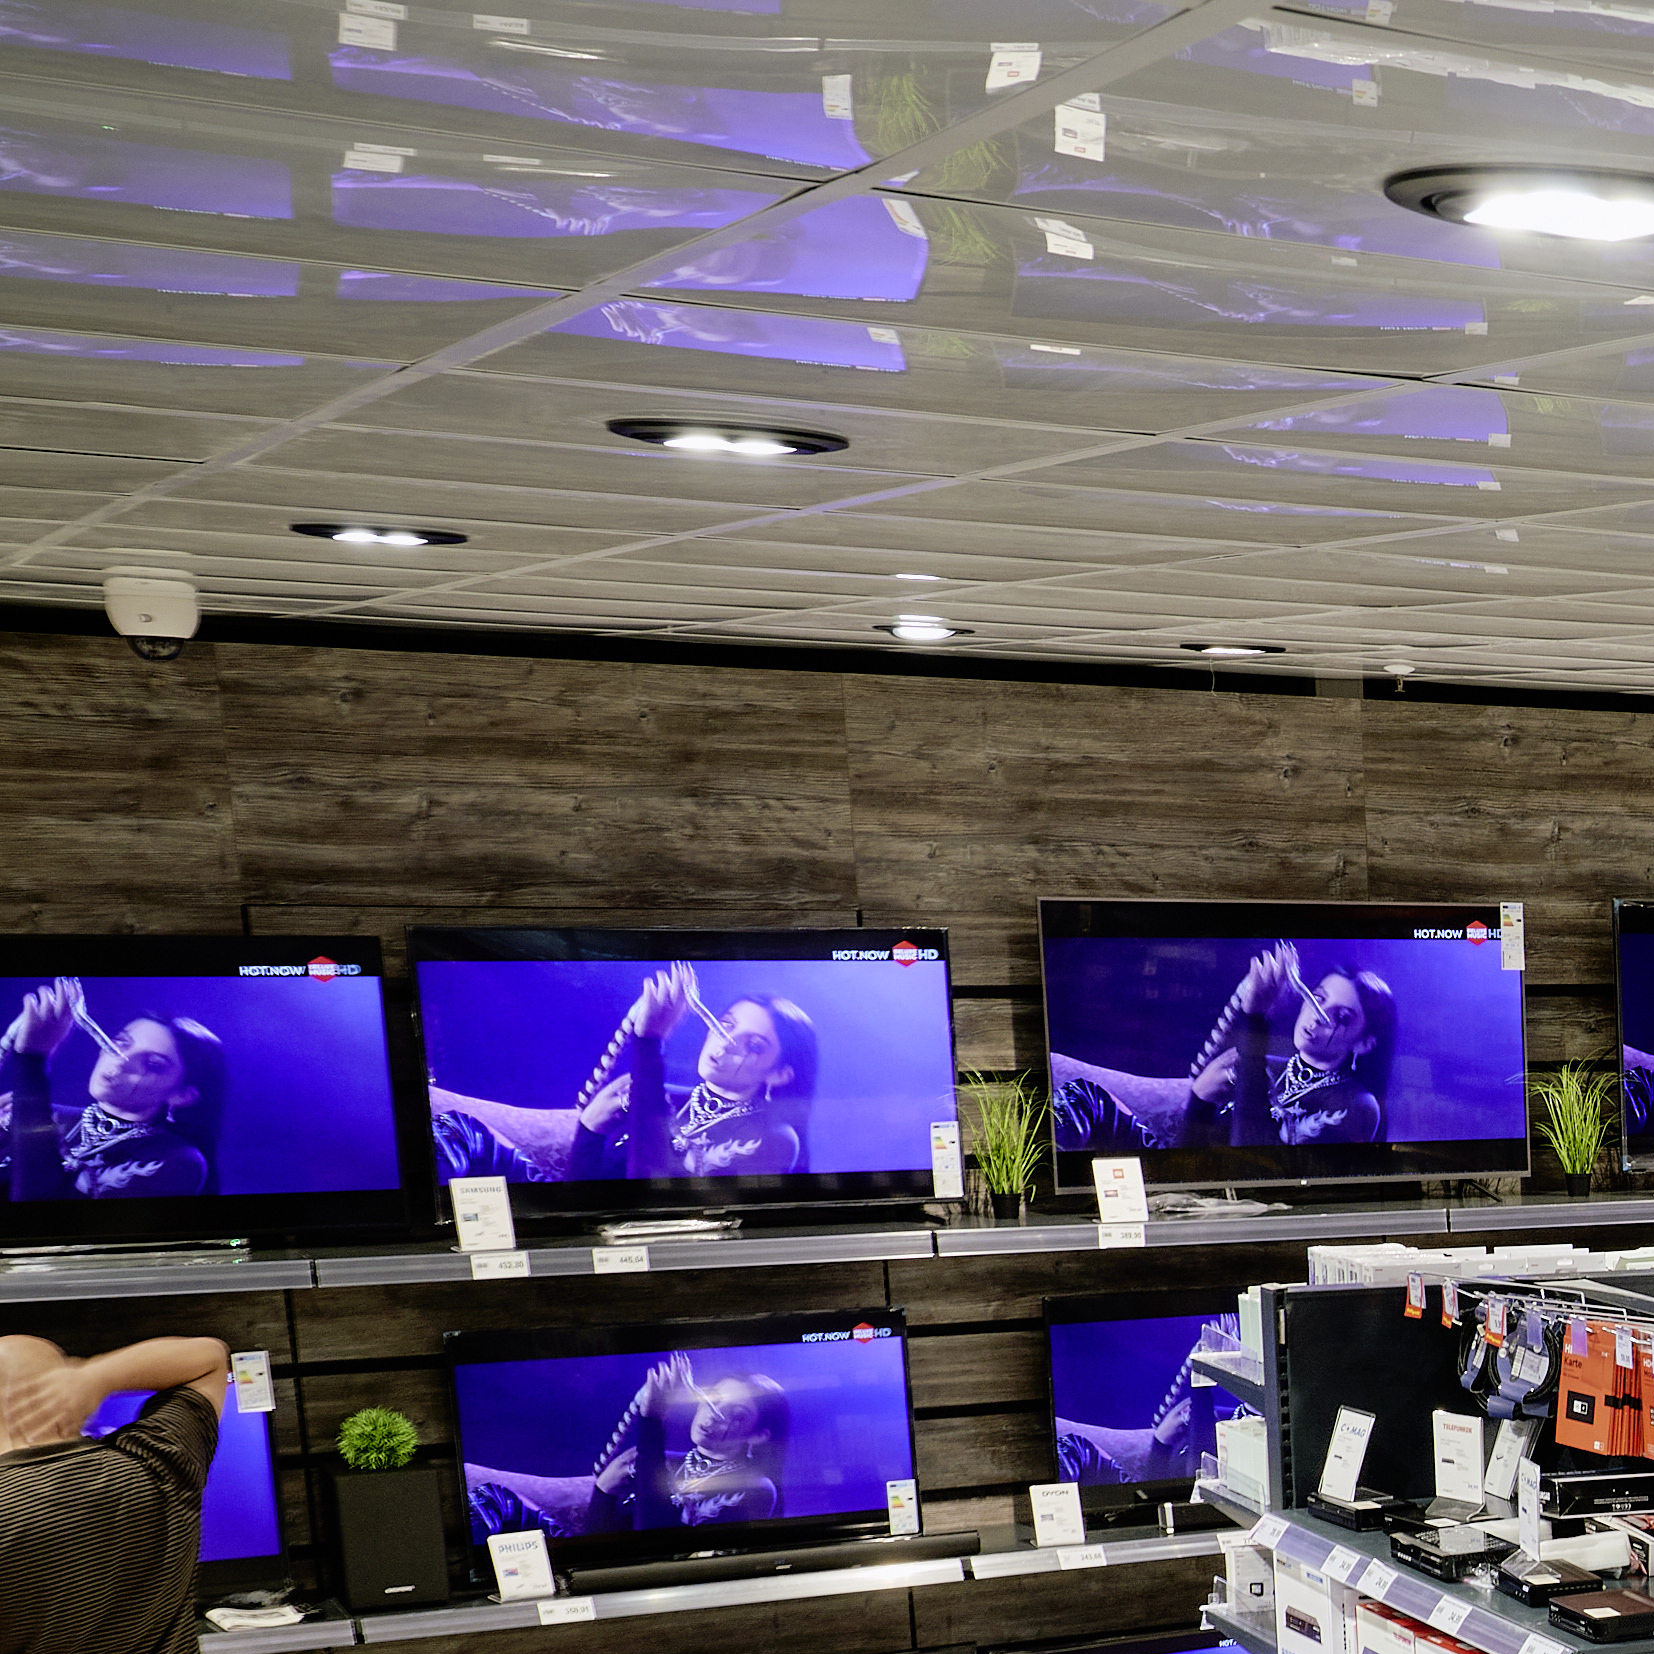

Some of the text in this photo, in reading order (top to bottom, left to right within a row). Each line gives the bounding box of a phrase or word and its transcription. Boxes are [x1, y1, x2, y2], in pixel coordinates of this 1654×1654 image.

[1414, 929, 1462, 940] HOT.NOW
[832, 949, 939, 961] HOT.NOW HD
[338, 964, 361, 976] HD
[802, 1328, 892, 1343] HOT.NOW HD
